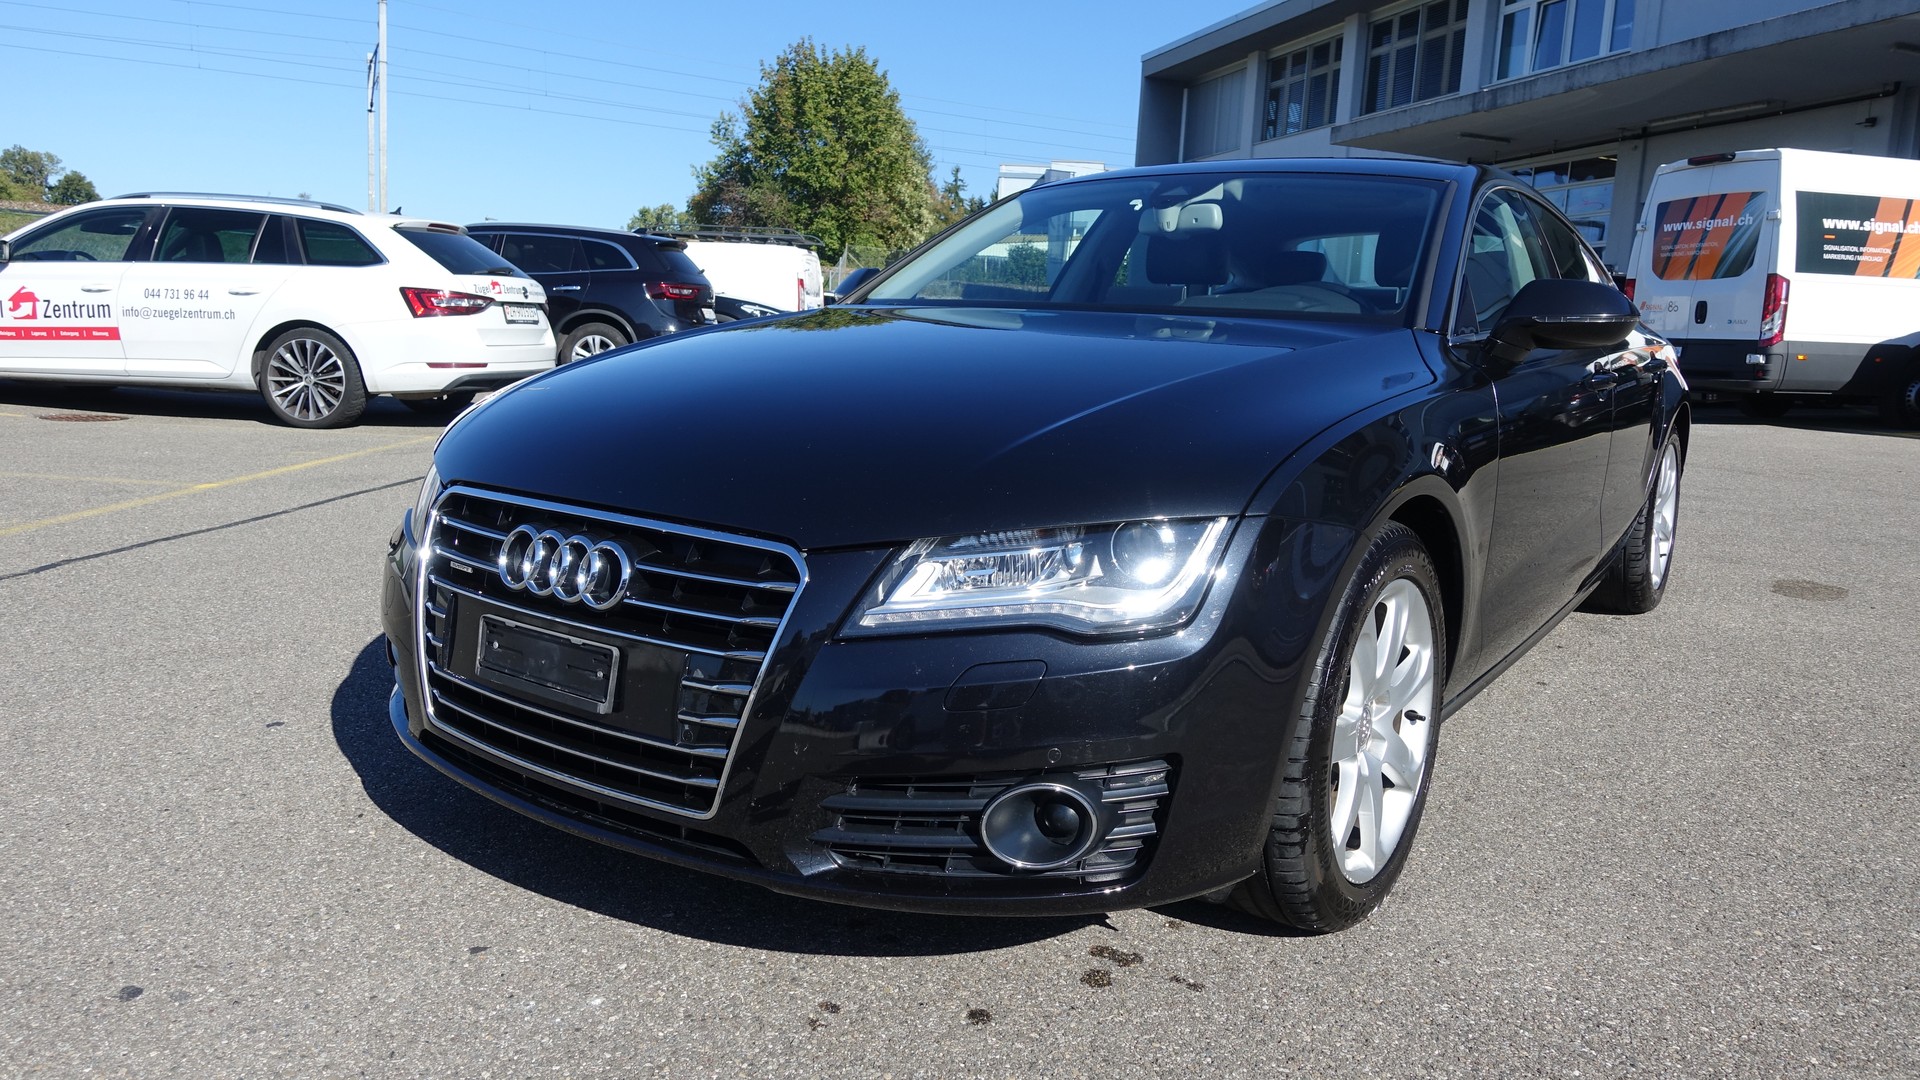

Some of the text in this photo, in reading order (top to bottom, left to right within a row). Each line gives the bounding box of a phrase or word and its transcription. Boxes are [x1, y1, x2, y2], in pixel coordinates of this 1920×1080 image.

[1663, 214, 1753, 232] www.signal.ch
[1822, 218, 1920, 235] www.signal.ch
[144, 288, 209, 300] 044 731 96 44
[503, 285, 522, 295] Zentrum
[43, 299, 111, 319] Zentrum
[121, 306, 236, 321] info@zuegelzentrum.ch
